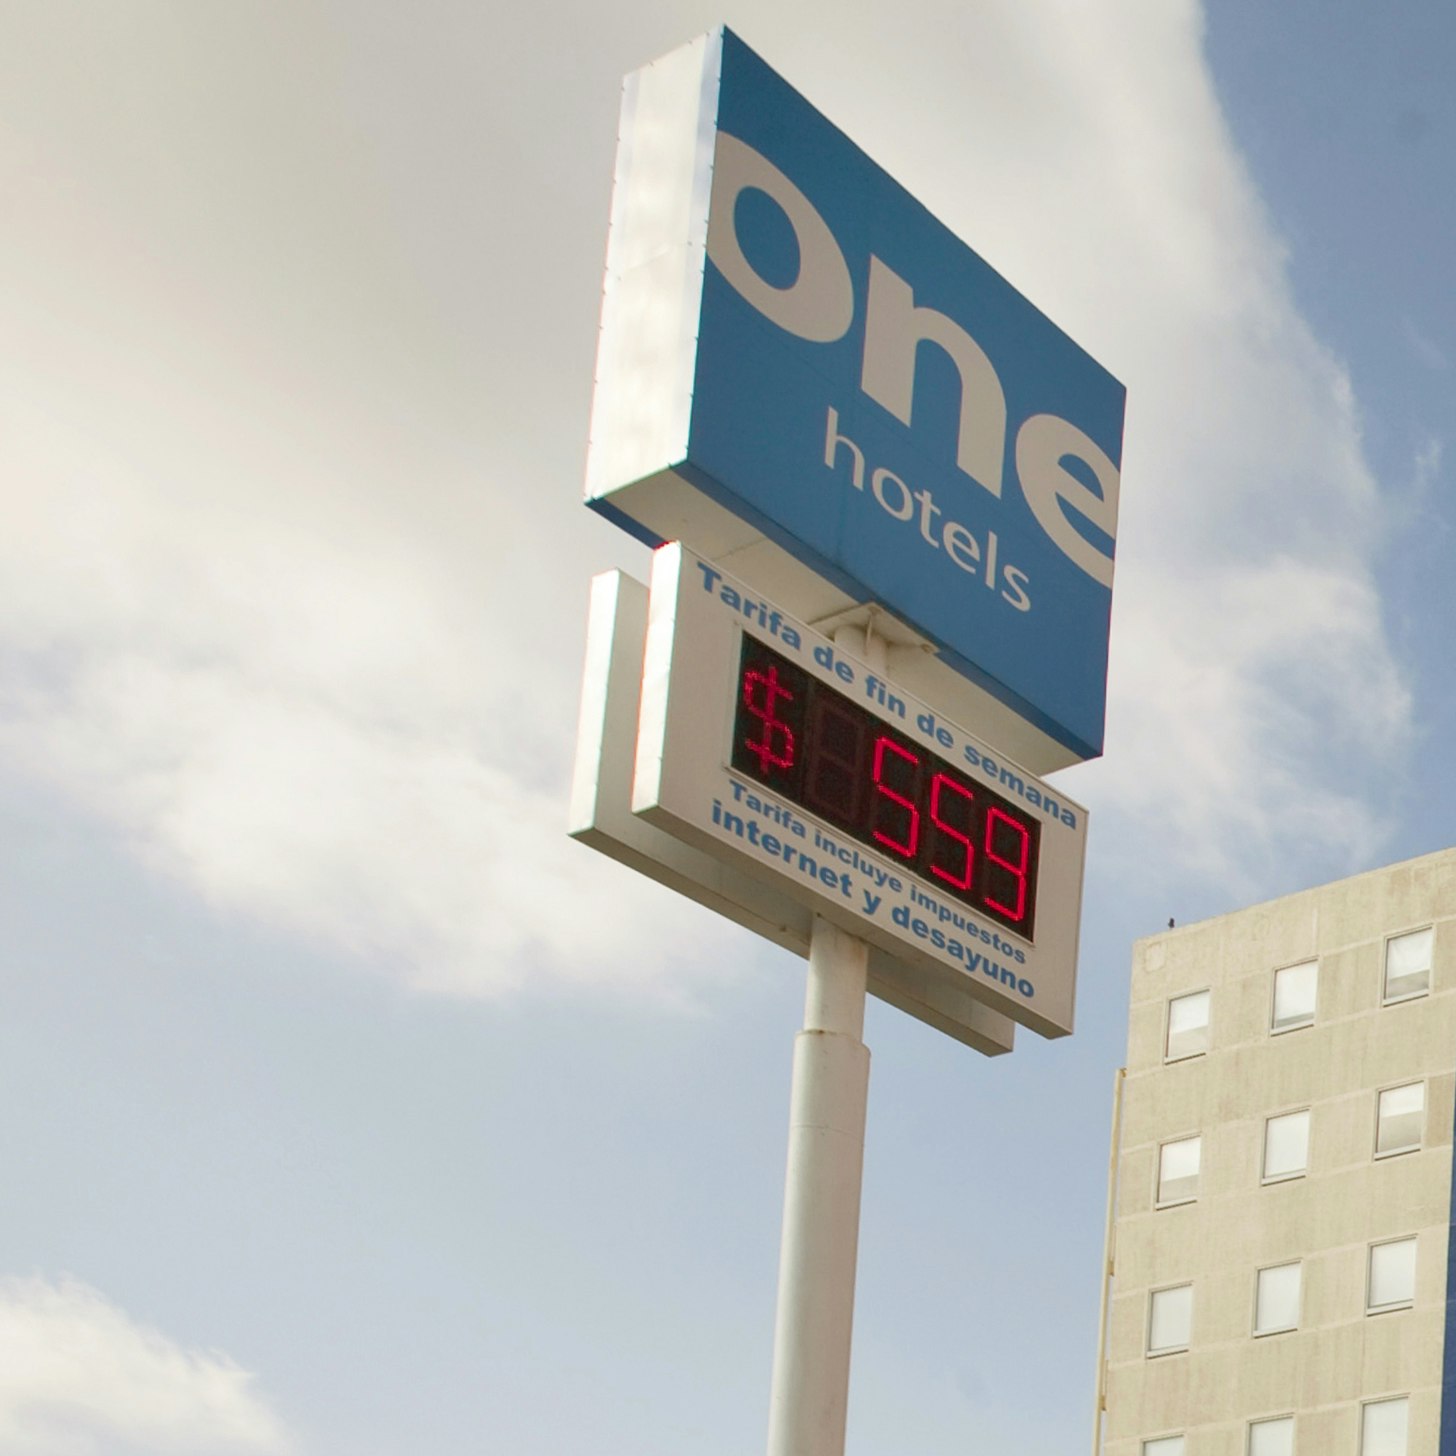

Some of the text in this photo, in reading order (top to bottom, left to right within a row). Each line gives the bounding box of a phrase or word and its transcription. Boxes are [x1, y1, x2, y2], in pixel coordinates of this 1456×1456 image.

[705, 130, 1121, 591] one
[823, 405, 1032, 612] hotels
[697, 562, 1077, 830] Tarifa de fin de semana
[711, 801, 1035, 998] internet y desayuno
[729, 779, 1027, 964] Tarifa incluye impuestos
[873, 736, 1030, 921] 559
